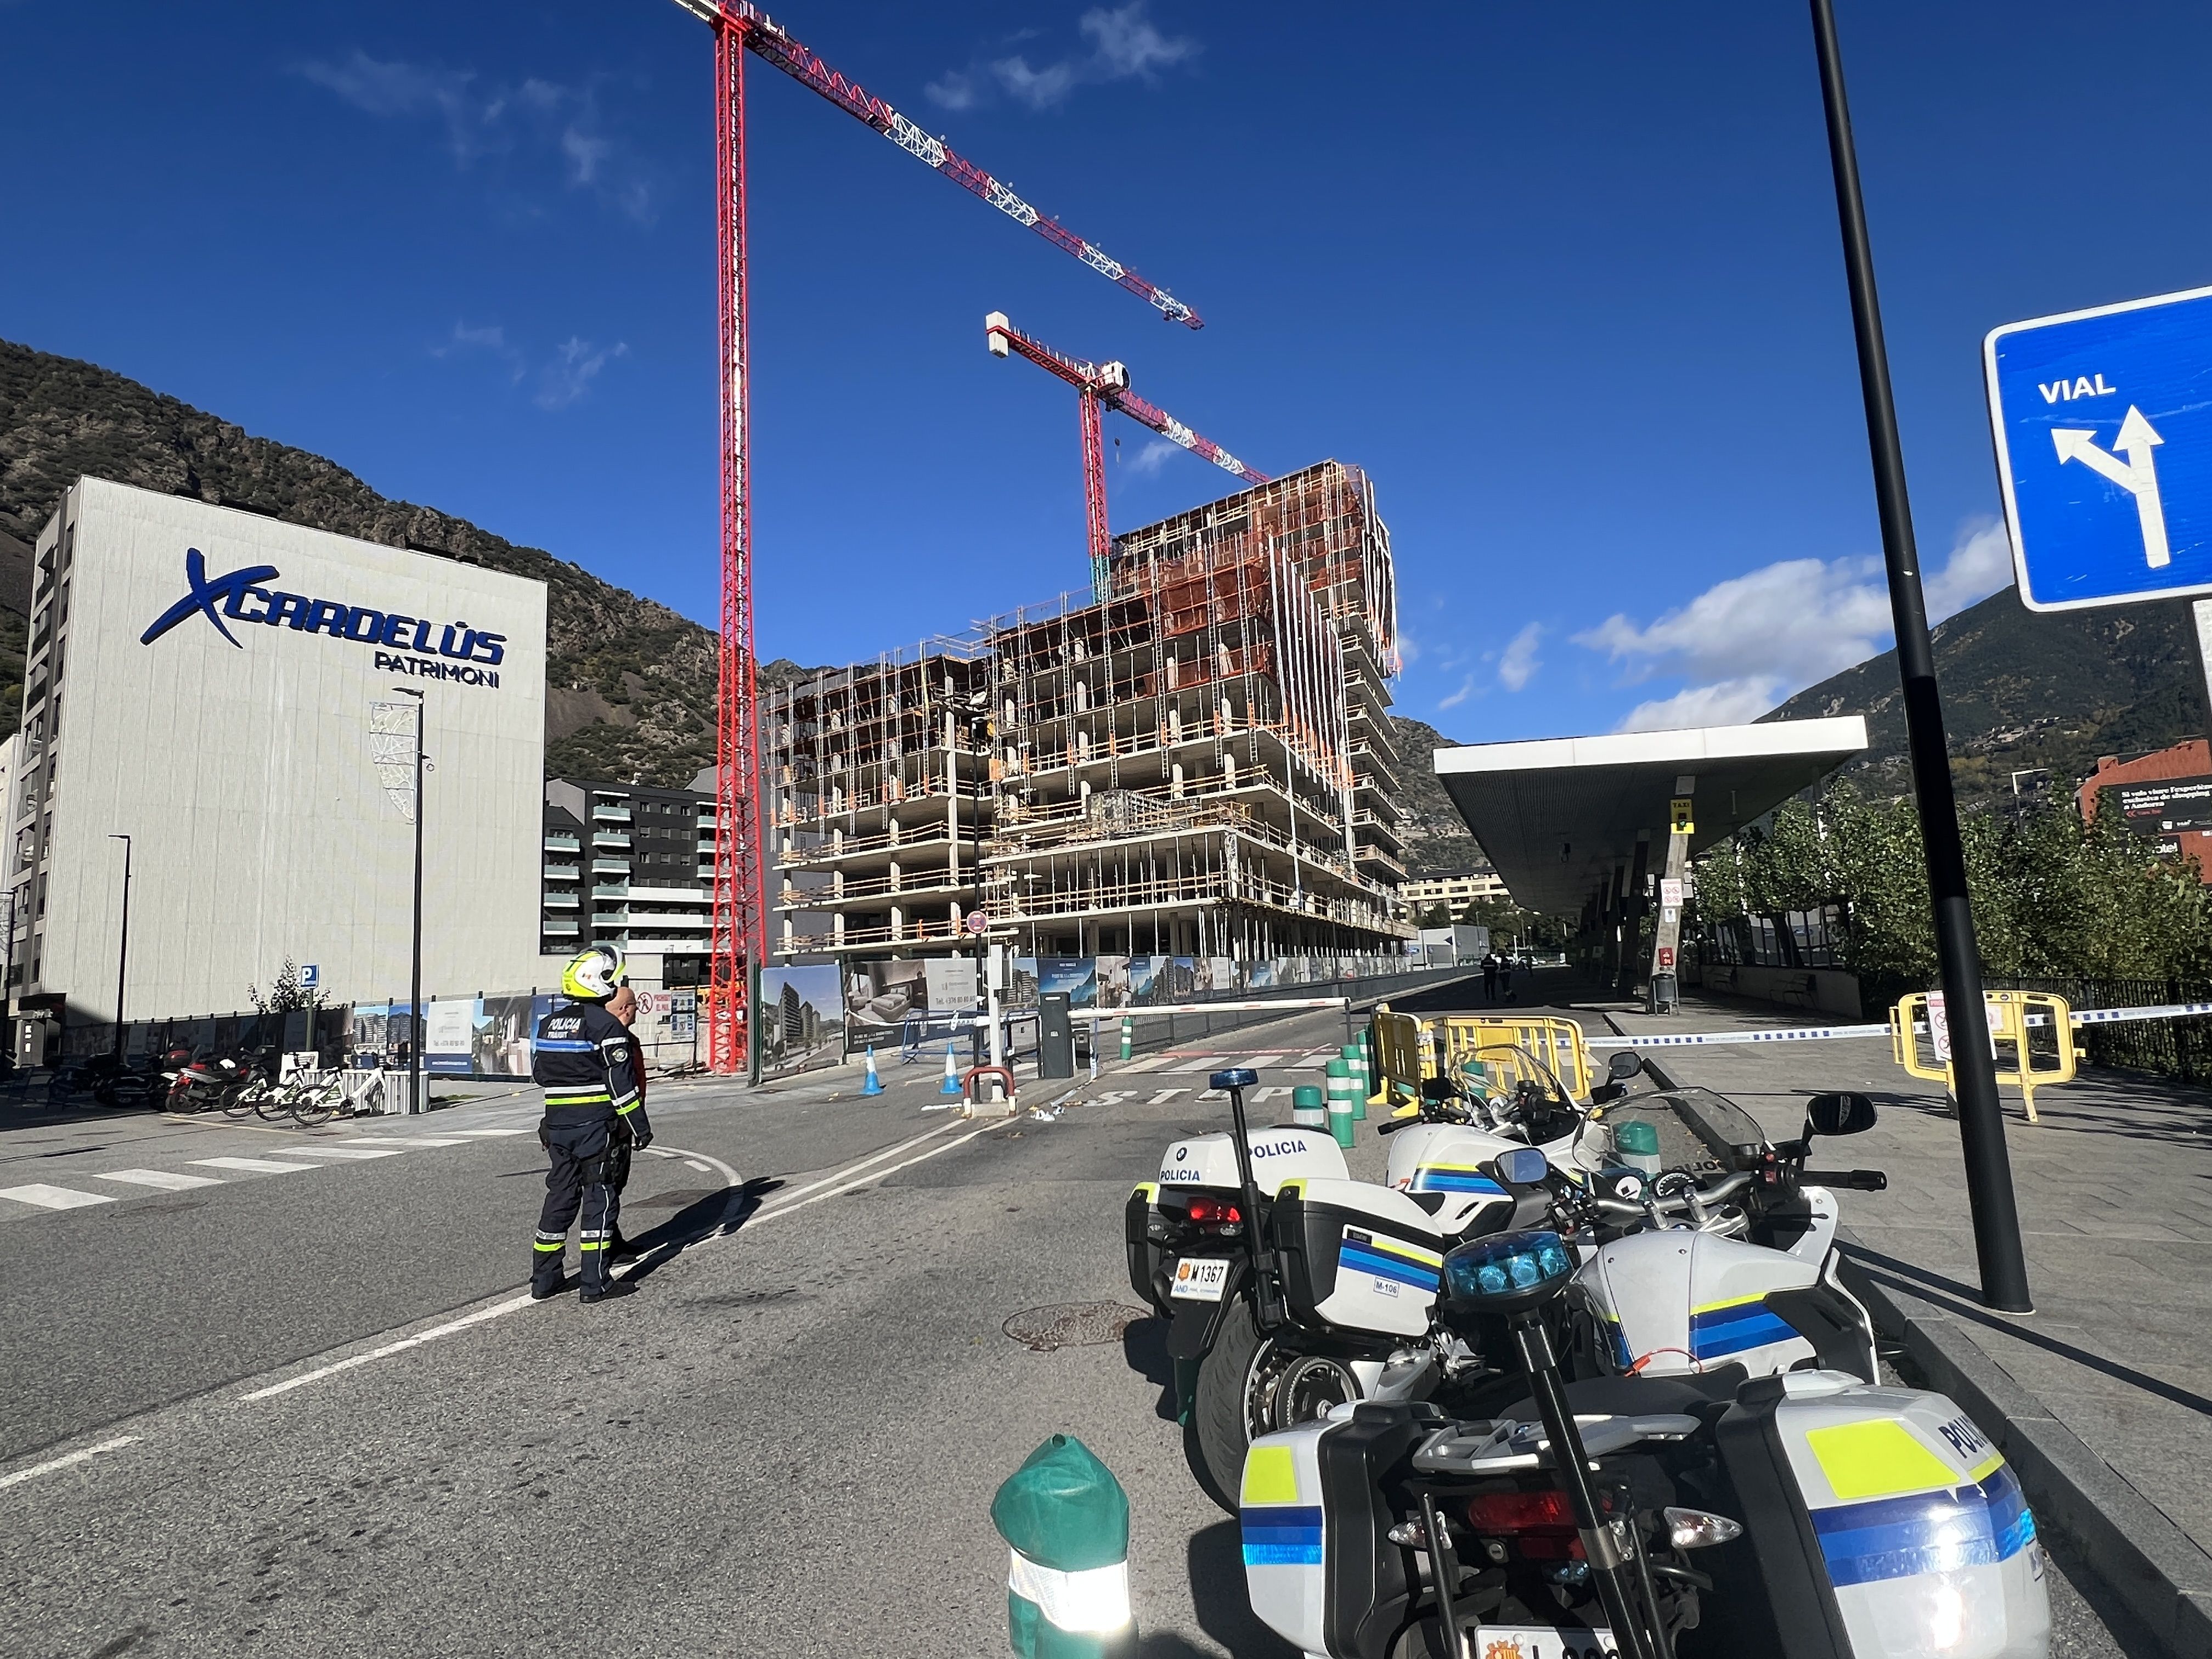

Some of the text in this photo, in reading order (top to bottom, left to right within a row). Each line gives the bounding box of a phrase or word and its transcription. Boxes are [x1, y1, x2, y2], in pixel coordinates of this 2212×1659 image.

[2038, 373, 2117, 404] VIAL
[374, 651, 499, 689] PATRIMONI
[301, 967, 313, 985] P
[548, 1018, 582, 1030] POLICIA
[1084, 1086, 1294, 1107] STOP
[1160, 1169, 1200, 1182] POLICIA
[1173, 1284, 1188, 1293] AND
[1375, 1280, 1397, 1294] M-106
